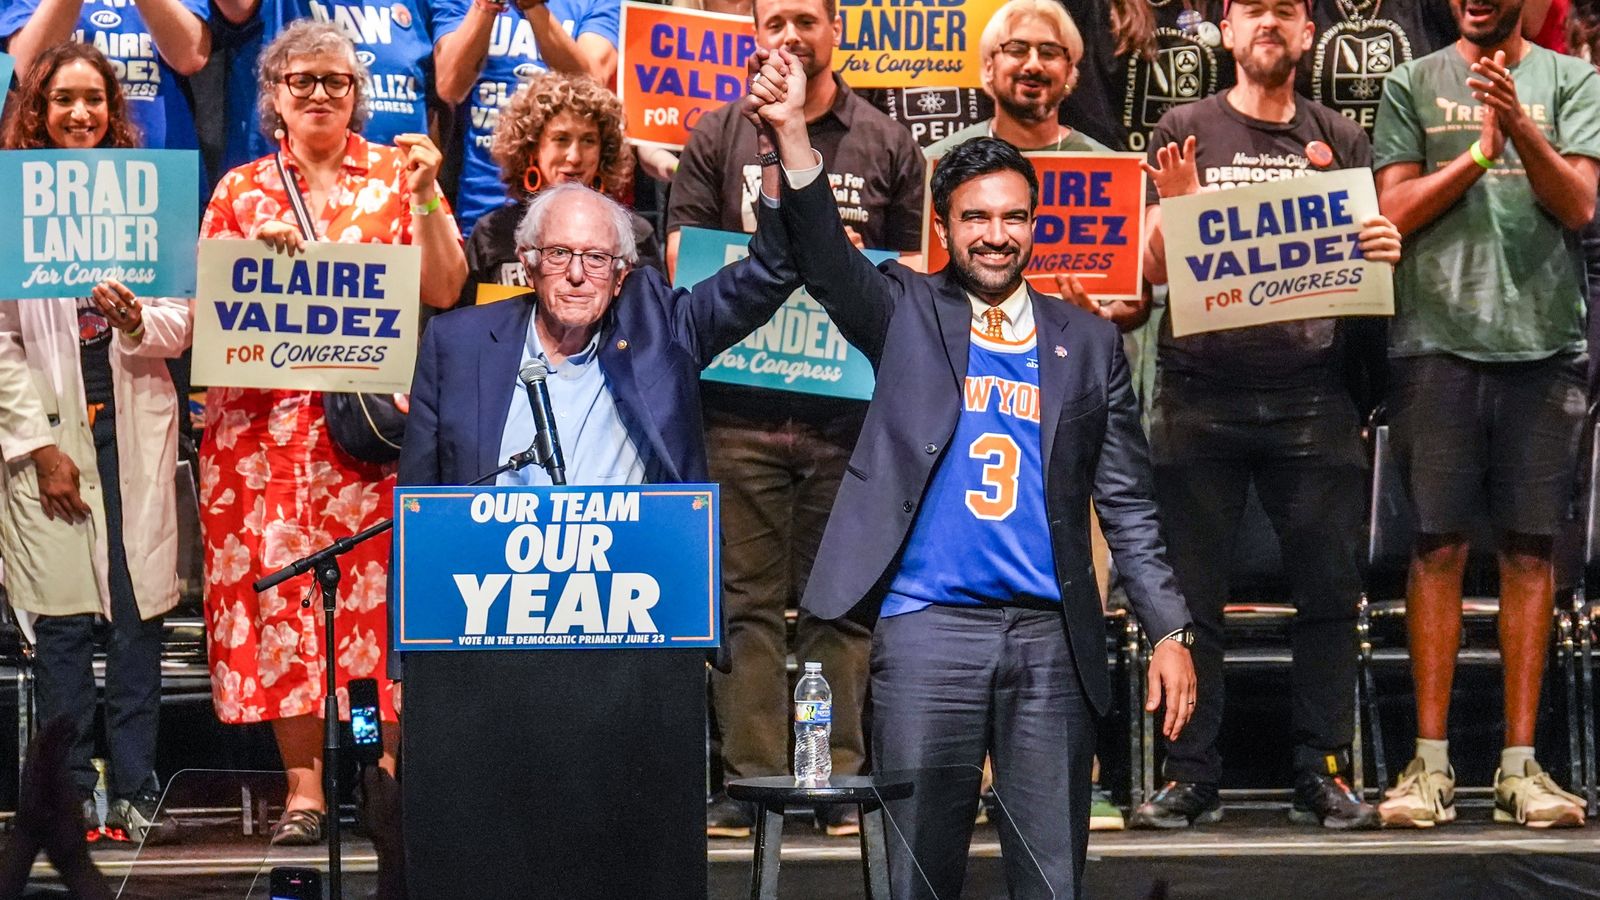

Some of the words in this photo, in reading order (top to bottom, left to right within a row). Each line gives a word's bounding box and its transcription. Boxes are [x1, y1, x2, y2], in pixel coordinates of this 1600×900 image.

[70, 29, 154, 58] AIRE
[488, 15, 575, 60] UA
[651, 23, 756, 68] CLAIR
[839, 10, 967, 51] LANDER
[107, 59, 161, 83] DEZ
[635, 64, 751, 102] VALD
[839, 54, 870, 73] for
[875, 53, 964, 79] Congress
[121, 83, 159, 97] RESS
[644, 107, 679, 126] FOR
[22, 160, 158, 216] BRAD
[844, 172, 866, 189] For
[1042, 171, 1113, 207] IRE
[1205, 167, 1321, 183] DEMOCRA
[838, 206, 869, 222] omic
[1033, 215, 1128, 245] DEZ
[1198, 190, 1354, 246] CLAIRE
[23, 216, 158, 263] LANDER
[22, 264, 61, 288] for
[64, 263, 155, 286] Congress
[231, 257, 387, 299] CLAIRE
[1028, 253, 1115, 271] NGRESS
[1205, 288, 1243, 312] FOR
[1249, 267, 1364, 306] CONGRESS
[214, 301, 401, 338] VALDEZ
[730, 308, 848, 361] NDER
[226, 345, 265, 365] FOR
[270, 342, 387, 368] CONGRESS
[750, 351, 843, 384] Congress
[965, 432, 1021, 521] 3
[470, 493, 540, 523] OUR
[549, 492, 640, 522] TEAM
[505, 524, 613, 573] OUR
[452, 572, 661, 635] YEAR
[458, 636, 482, 645] VOTE
[484, 636, 495, 645] IN
[497, 635, 514, 645] THE
[516, 635, 577, 645] DEMOCRATIC
[578, 634, 623, 644] PRIMARY
[625, 634, 649, 643] JUNE
[651, 634, 665, 643] 23
